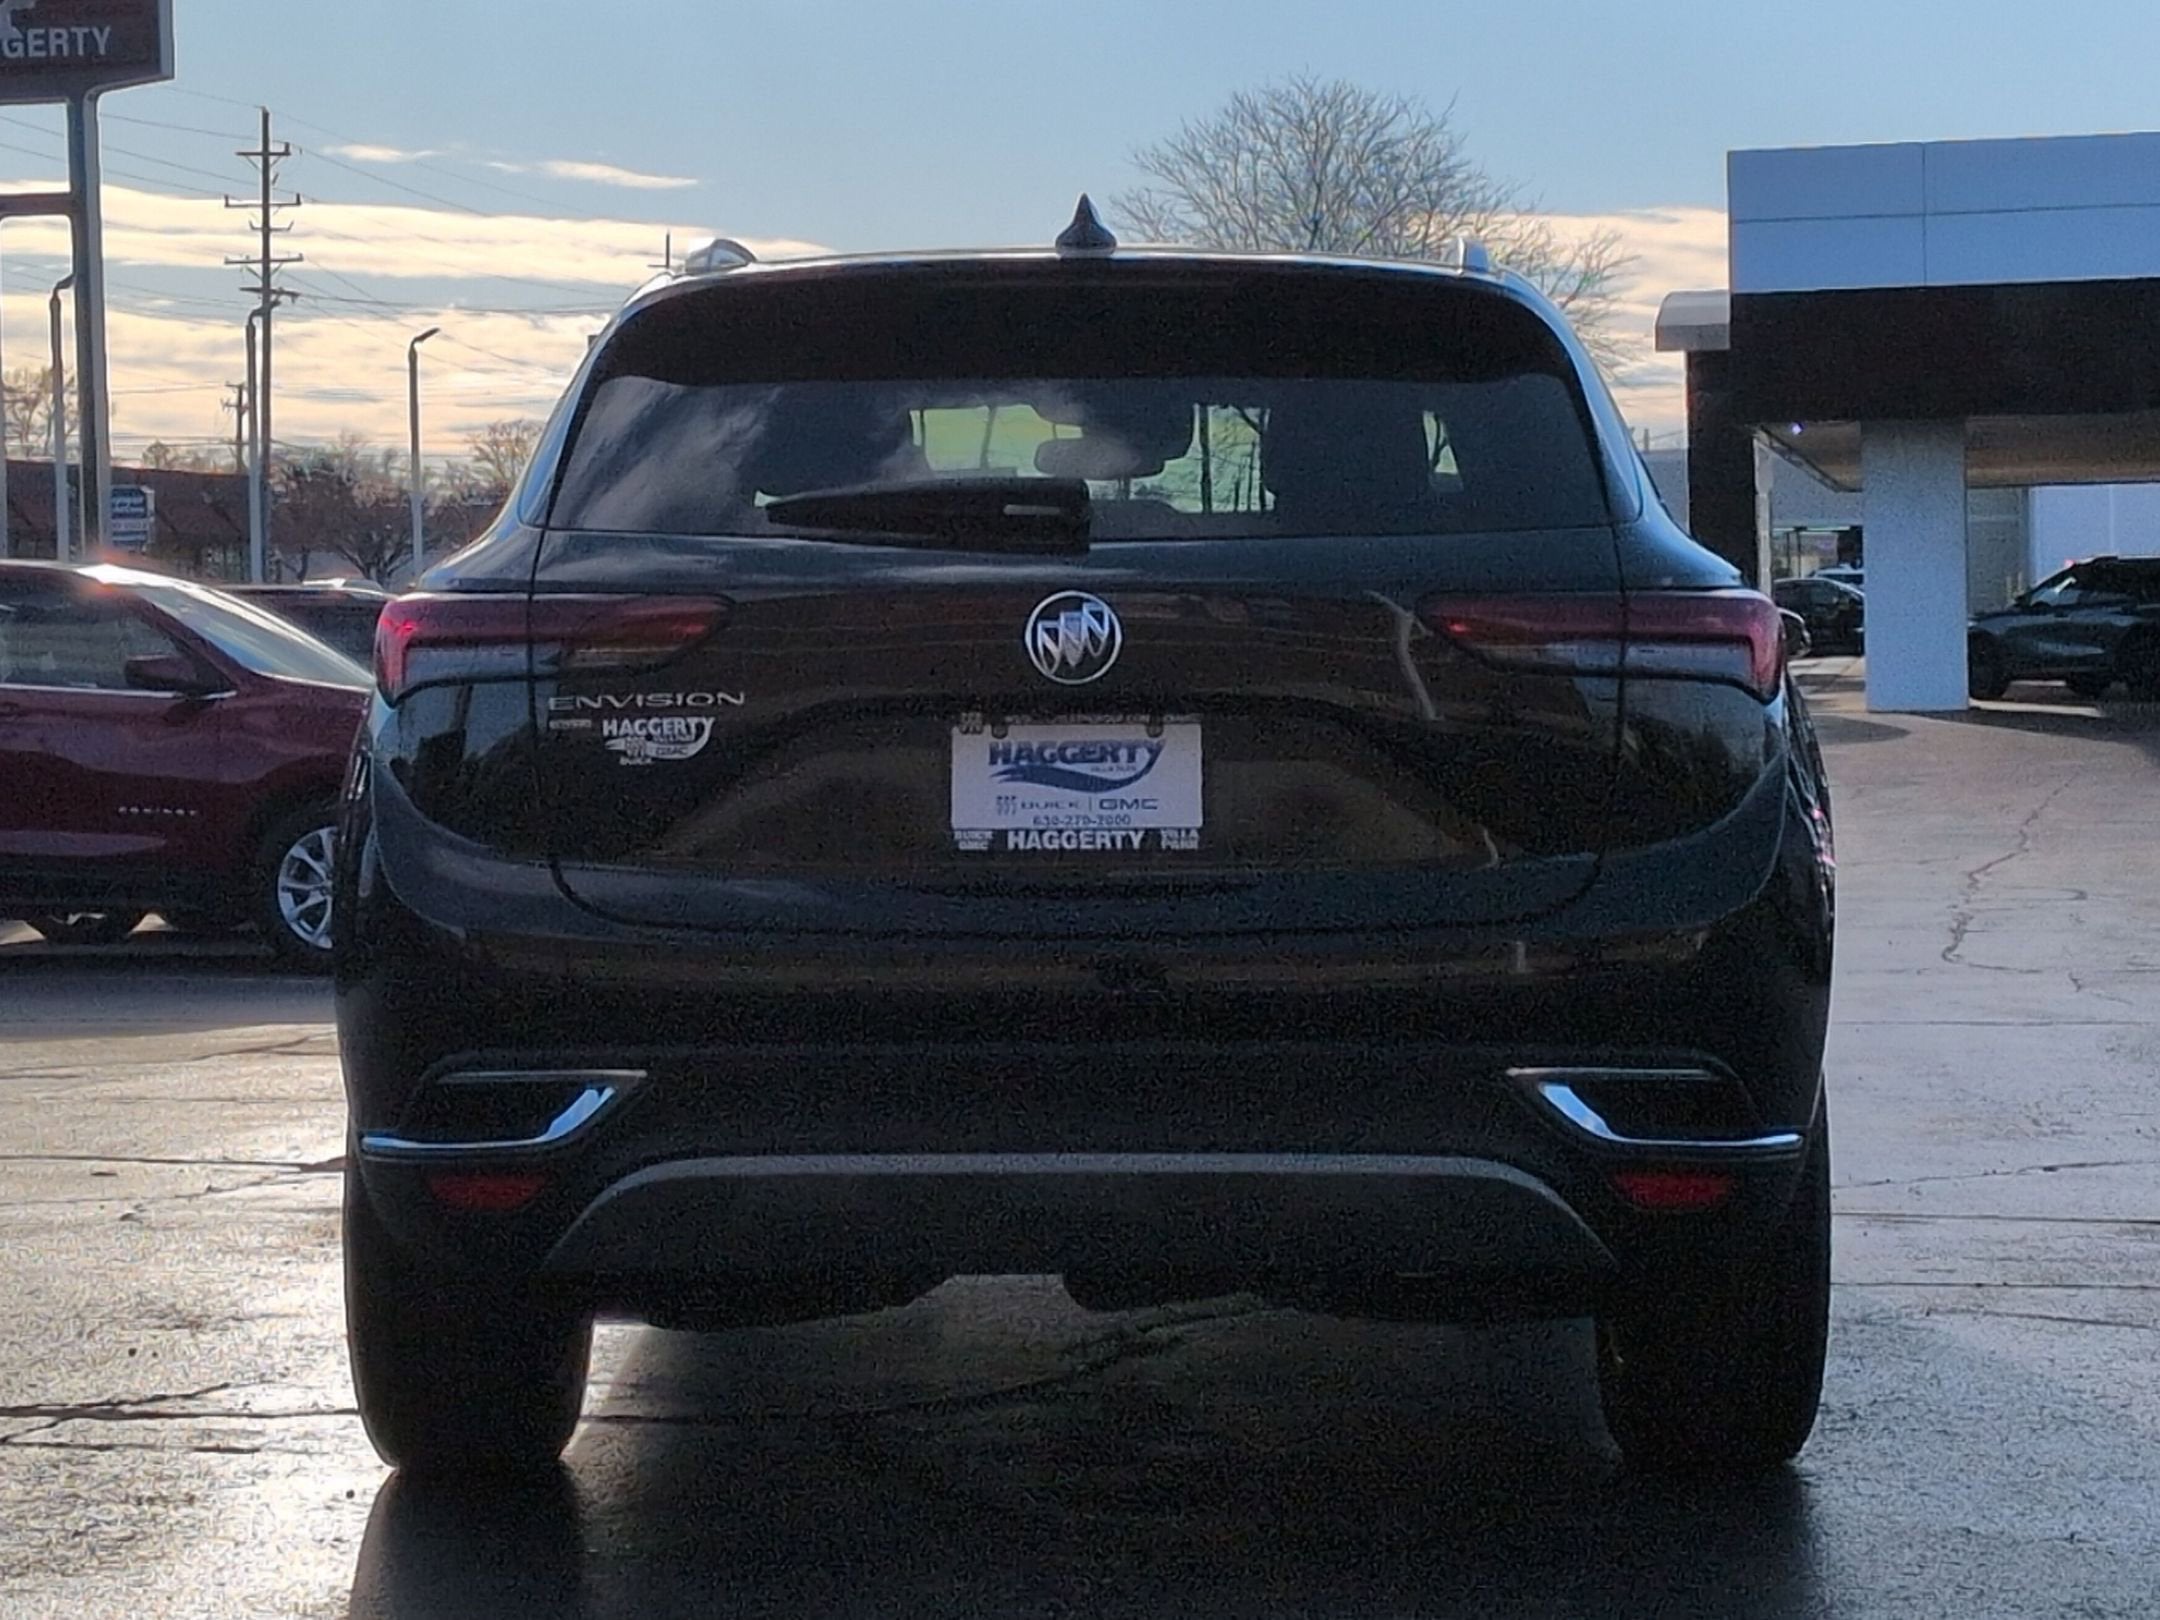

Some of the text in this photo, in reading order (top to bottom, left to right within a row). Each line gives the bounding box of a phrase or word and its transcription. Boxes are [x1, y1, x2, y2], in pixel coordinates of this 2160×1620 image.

[549, 691, 745, 711] ENVISION
[602, 716, 715, 738] HAGGERTY
[988, 738, 1166, 766] HAGGERTY
[1020, 798, 1159, 811] BUICK GMC
[1007, 830, 1146, 851] HAGGERTY
